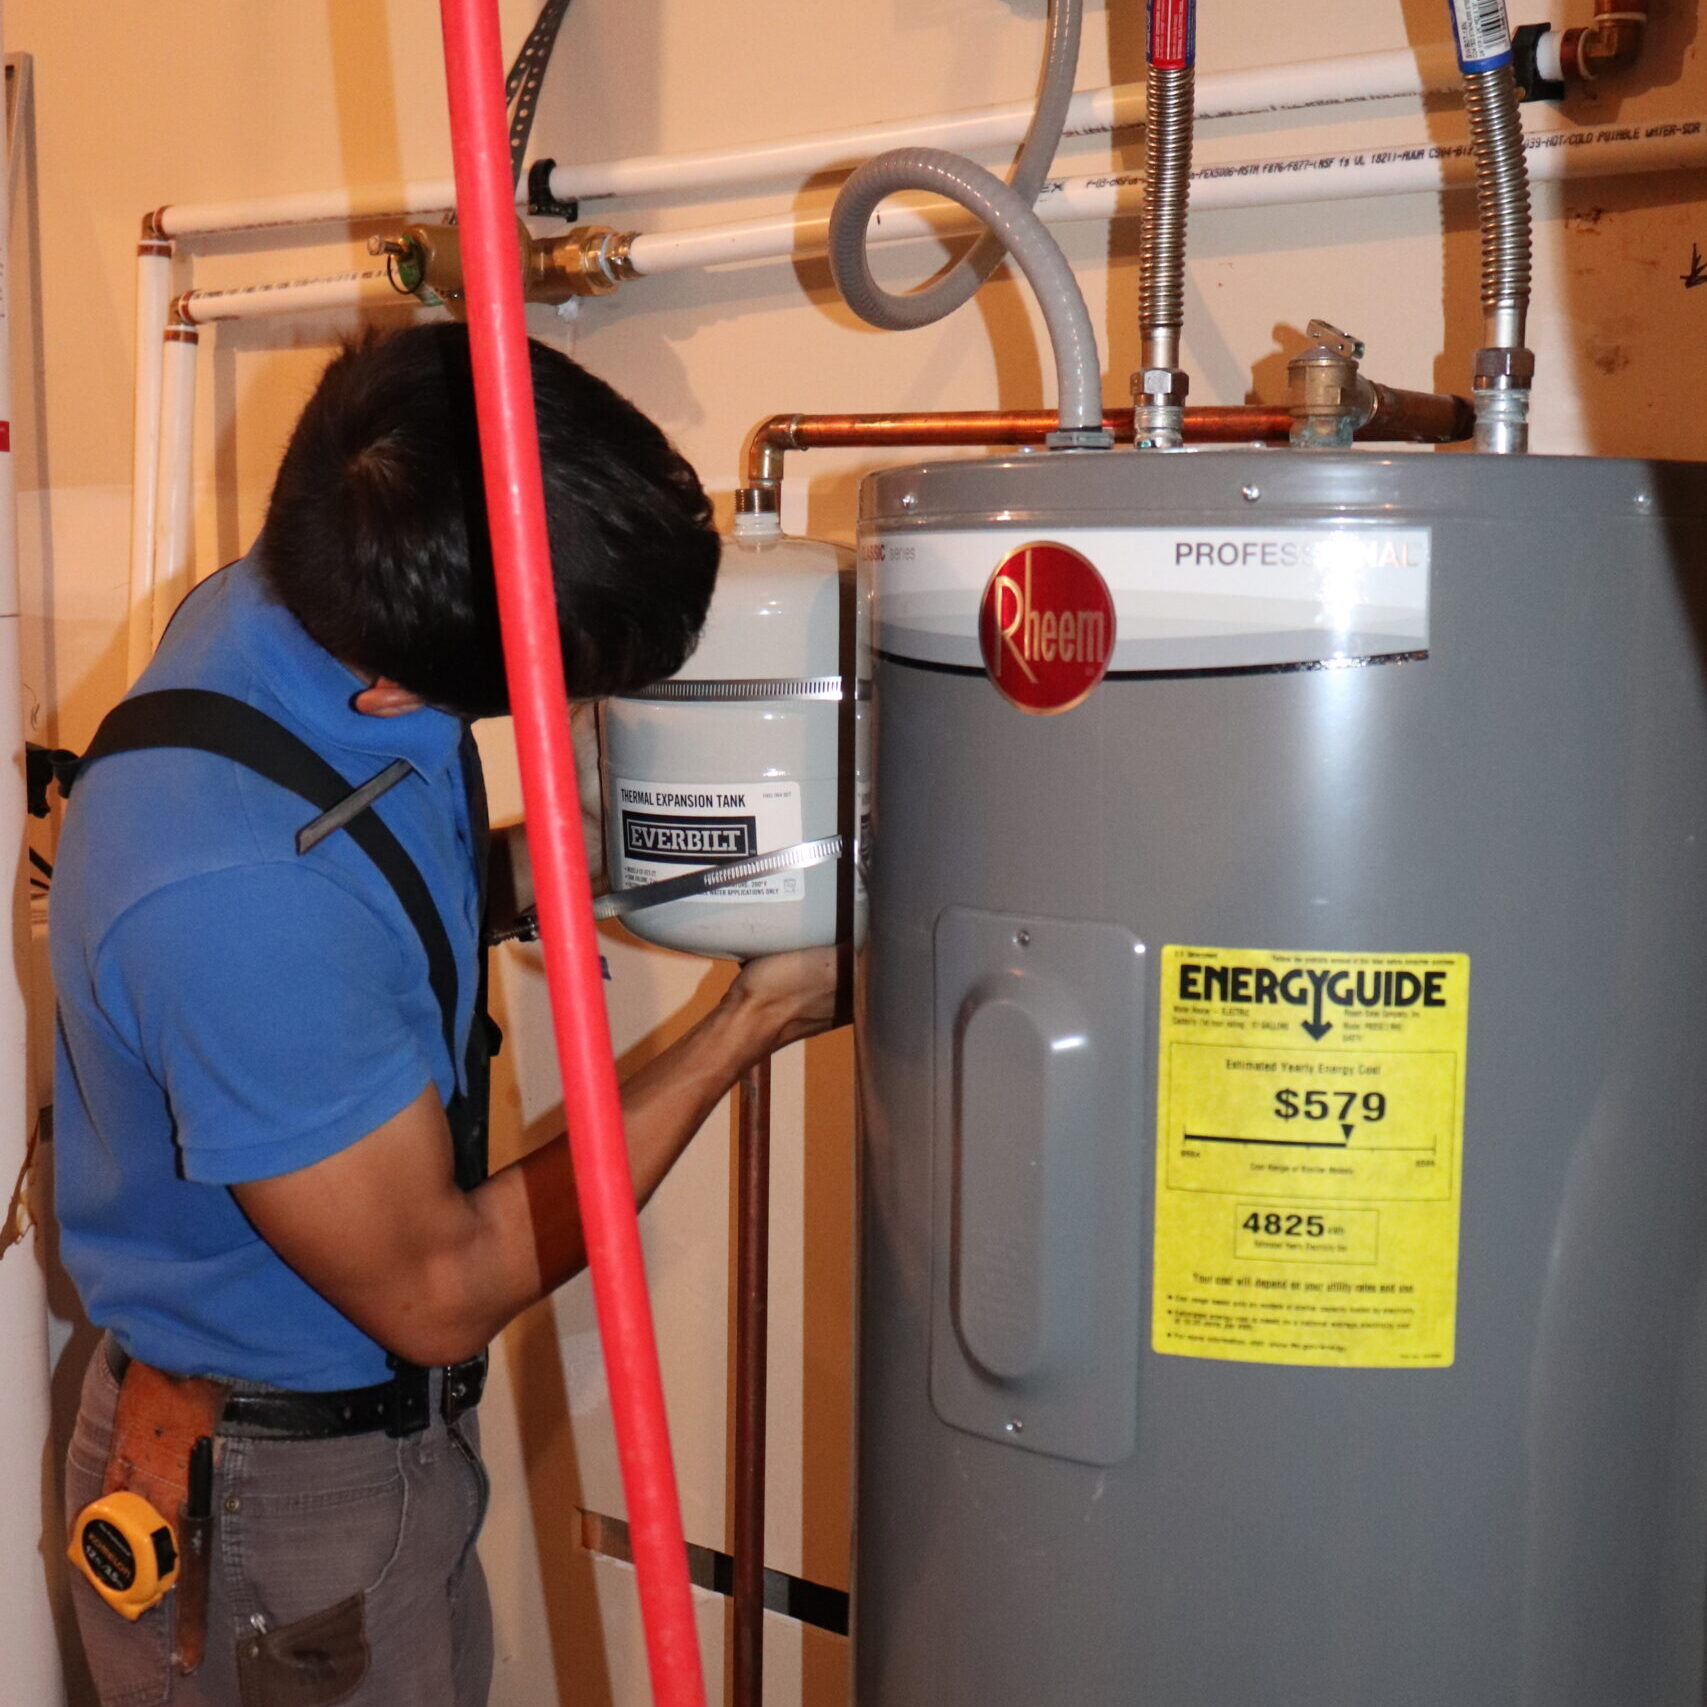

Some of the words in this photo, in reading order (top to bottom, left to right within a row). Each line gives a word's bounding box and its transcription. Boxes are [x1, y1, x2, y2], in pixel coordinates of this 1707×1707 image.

[995, 549, 1103, 684] Rheem
[621, 788, 654, 806] THERMAL
[656, 793, 712, 808] EXPANSION
[716, 794, 746, 808] TANK
[630, 824, 741, 852] EVERBILT
[1179, 964, 1447, 1009] ENERGYGUIDE
[1225, 1058, 1277, 1072] Estimated
[1281, 1061, 1314, 1075] Yearly
[1318, 1064, 1354, 1077] Energy
[1274, 1088, 1386, 1122] $579
[1242, 1211, 1325, 1237] 4825
